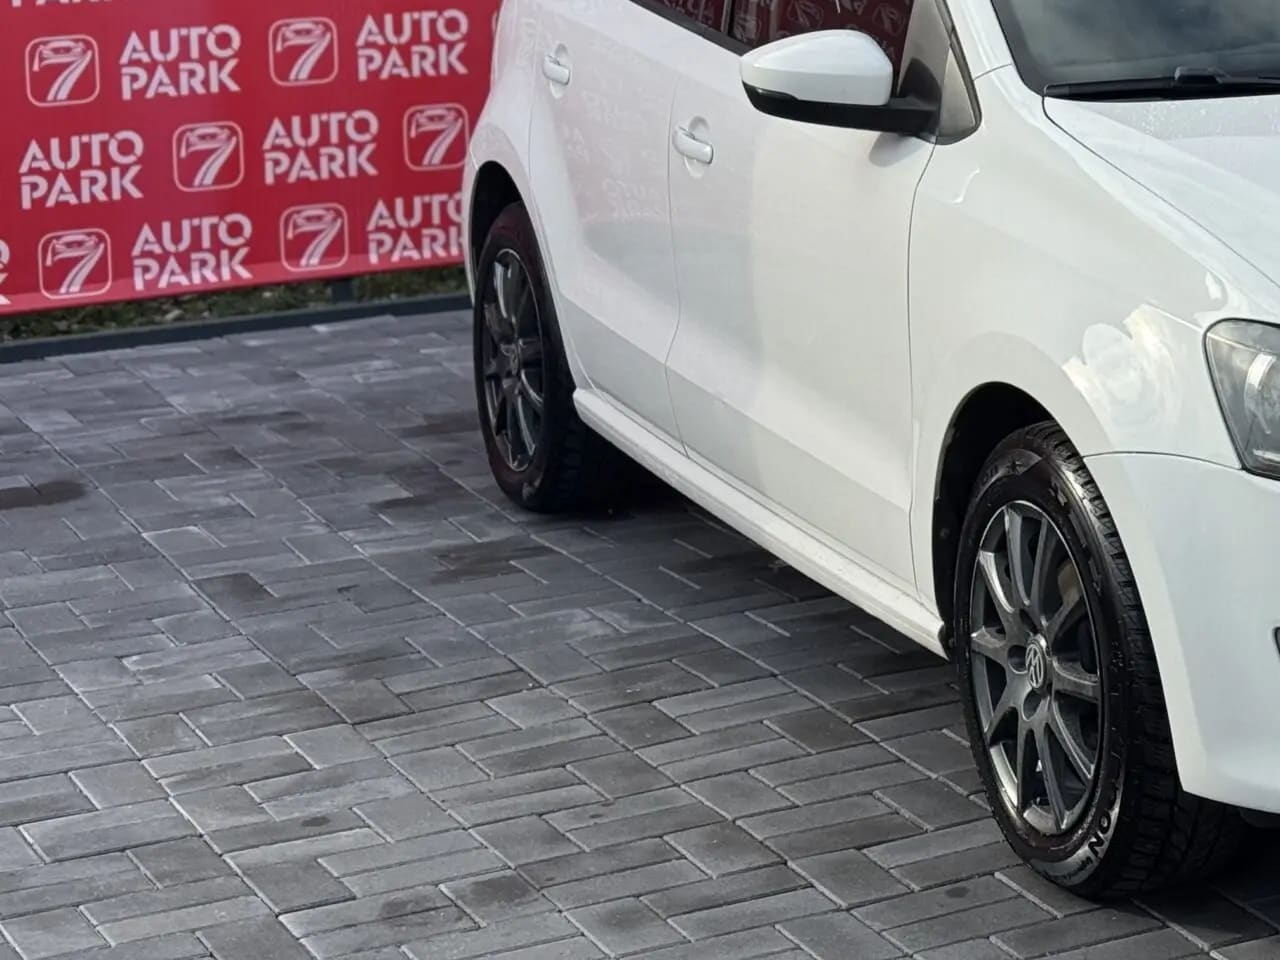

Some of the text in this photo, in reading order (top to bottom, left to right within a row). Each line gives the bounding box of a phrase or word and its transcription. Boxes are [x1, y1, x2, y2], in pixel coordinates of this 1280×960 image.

[119, 23, 242, 66] AUTO
[355, 8, 469, 48] AUTO
[120, 57, 241, 101] PARK
[356, 41, 469, 82] PARK
[18, 129, 145, 174] AUTO
[262, 108, 380, 151] AUTO
[263, 142, 379, 186] PARK
[20, 164, 144, 210] PARK
[131, 212, 253, 257] AUTO
[132, 246, 256, 292] PARK
